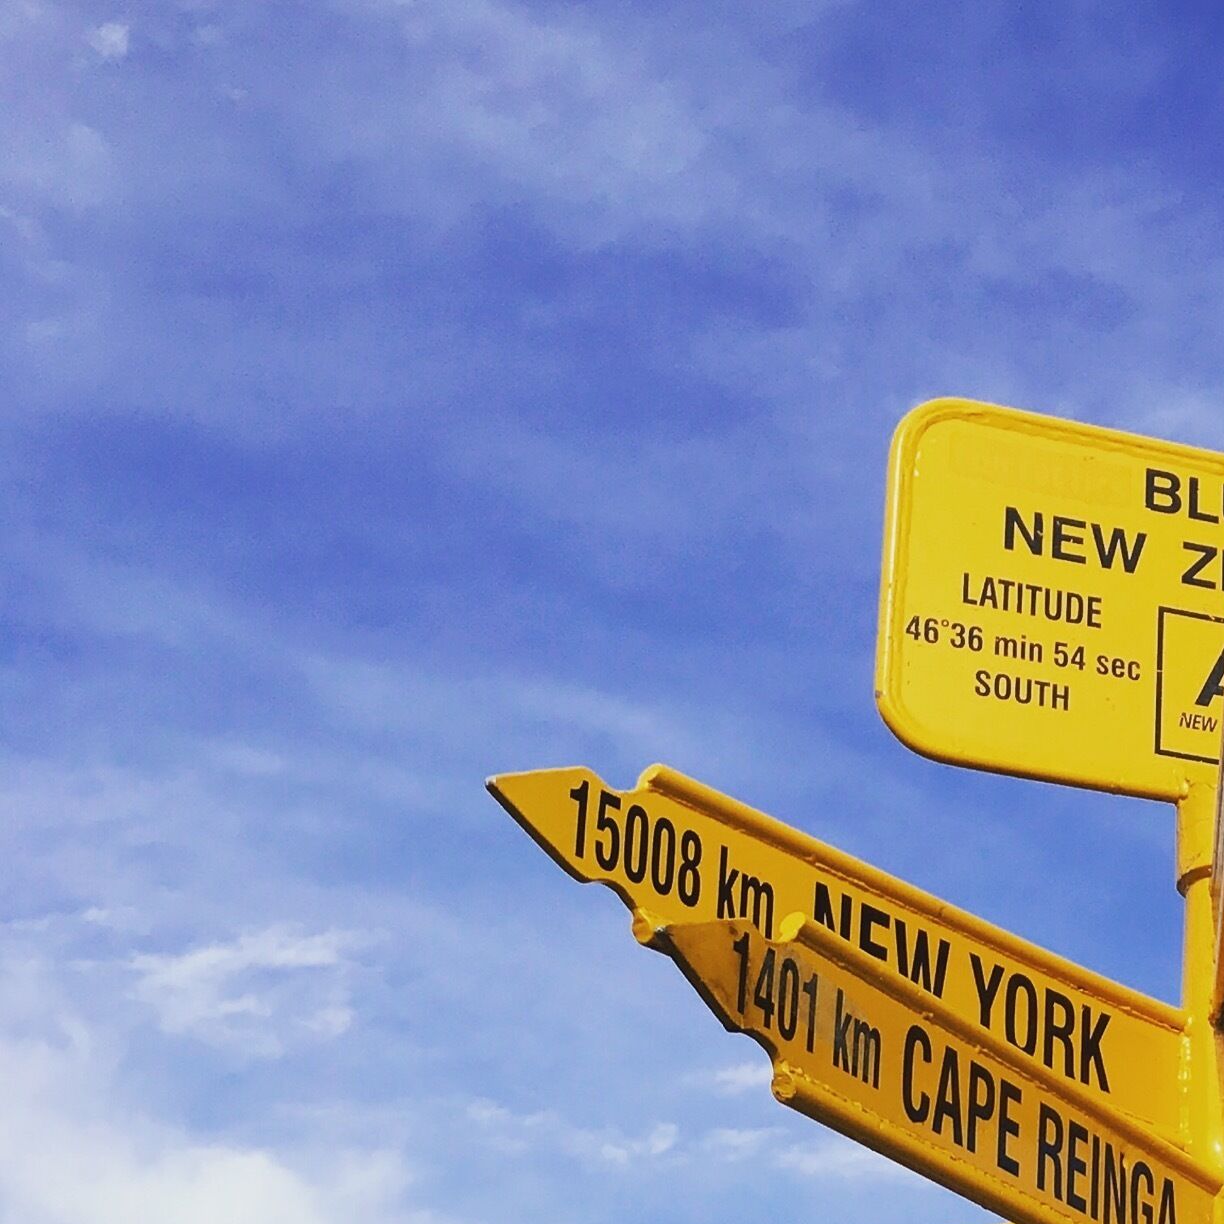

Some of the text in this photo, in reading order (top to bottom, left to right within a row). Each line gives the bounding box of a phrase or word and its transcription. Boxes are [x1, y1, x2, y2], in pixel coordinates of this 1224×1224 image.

[1003, 506, 1147, 574] NEW
[962, 573, 1102, 629] LATITUDE
[994, 635, 1043, 663] min
[1053, 642, 1086, 671] 54
[1096, 655, 1141, 681] sec
[974, 670, 1070, 712] SOUTH
[1178, 712, 1218, 733] NEW
[570, 780, 1111, 1094] 15008 km NEW YORK
[733, 931, 818, 1054] 1401
[832, 987, 882, 1090] km
[902, 1024, 1022, 1178] CAPE
